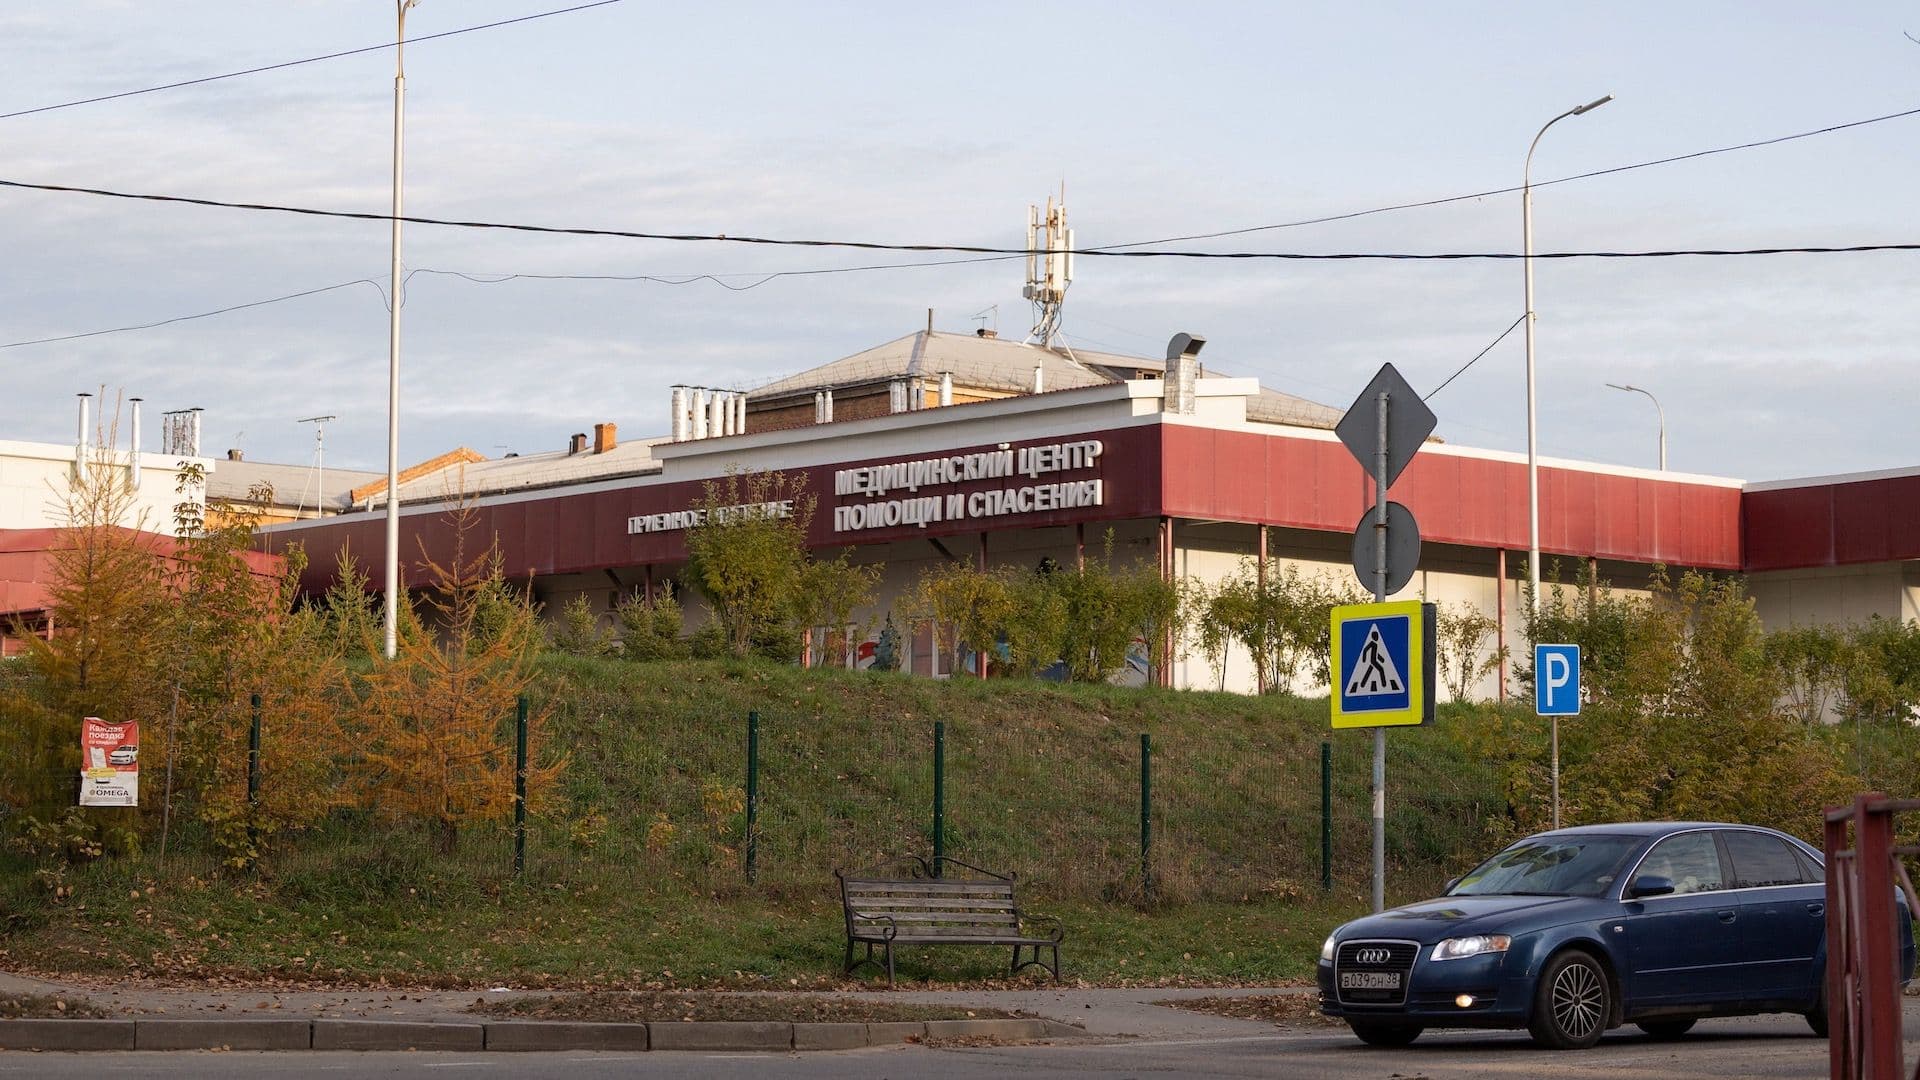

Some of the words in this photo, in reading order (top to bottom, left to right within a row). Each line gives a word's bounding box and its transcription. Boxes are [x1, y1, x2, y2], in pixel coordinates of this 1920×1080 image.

[834, 443, 1014, 497] МЕДИЦИНСКИЙ
[1017, 440, 1103, 479] ЦЕНТР
[627, 509, 707, 535] ПРИЕМНОЕ
[834, 495, 943, 532] ПОМОЩИ
[946, 493, 965, 520] И
[968, 478, 1103, 519] СПАСЕНИЯ
[1546, 652, 1570, 707] P
[88, 732, 125, 740] поездка
[1384, 972, 1397, 984] 38
